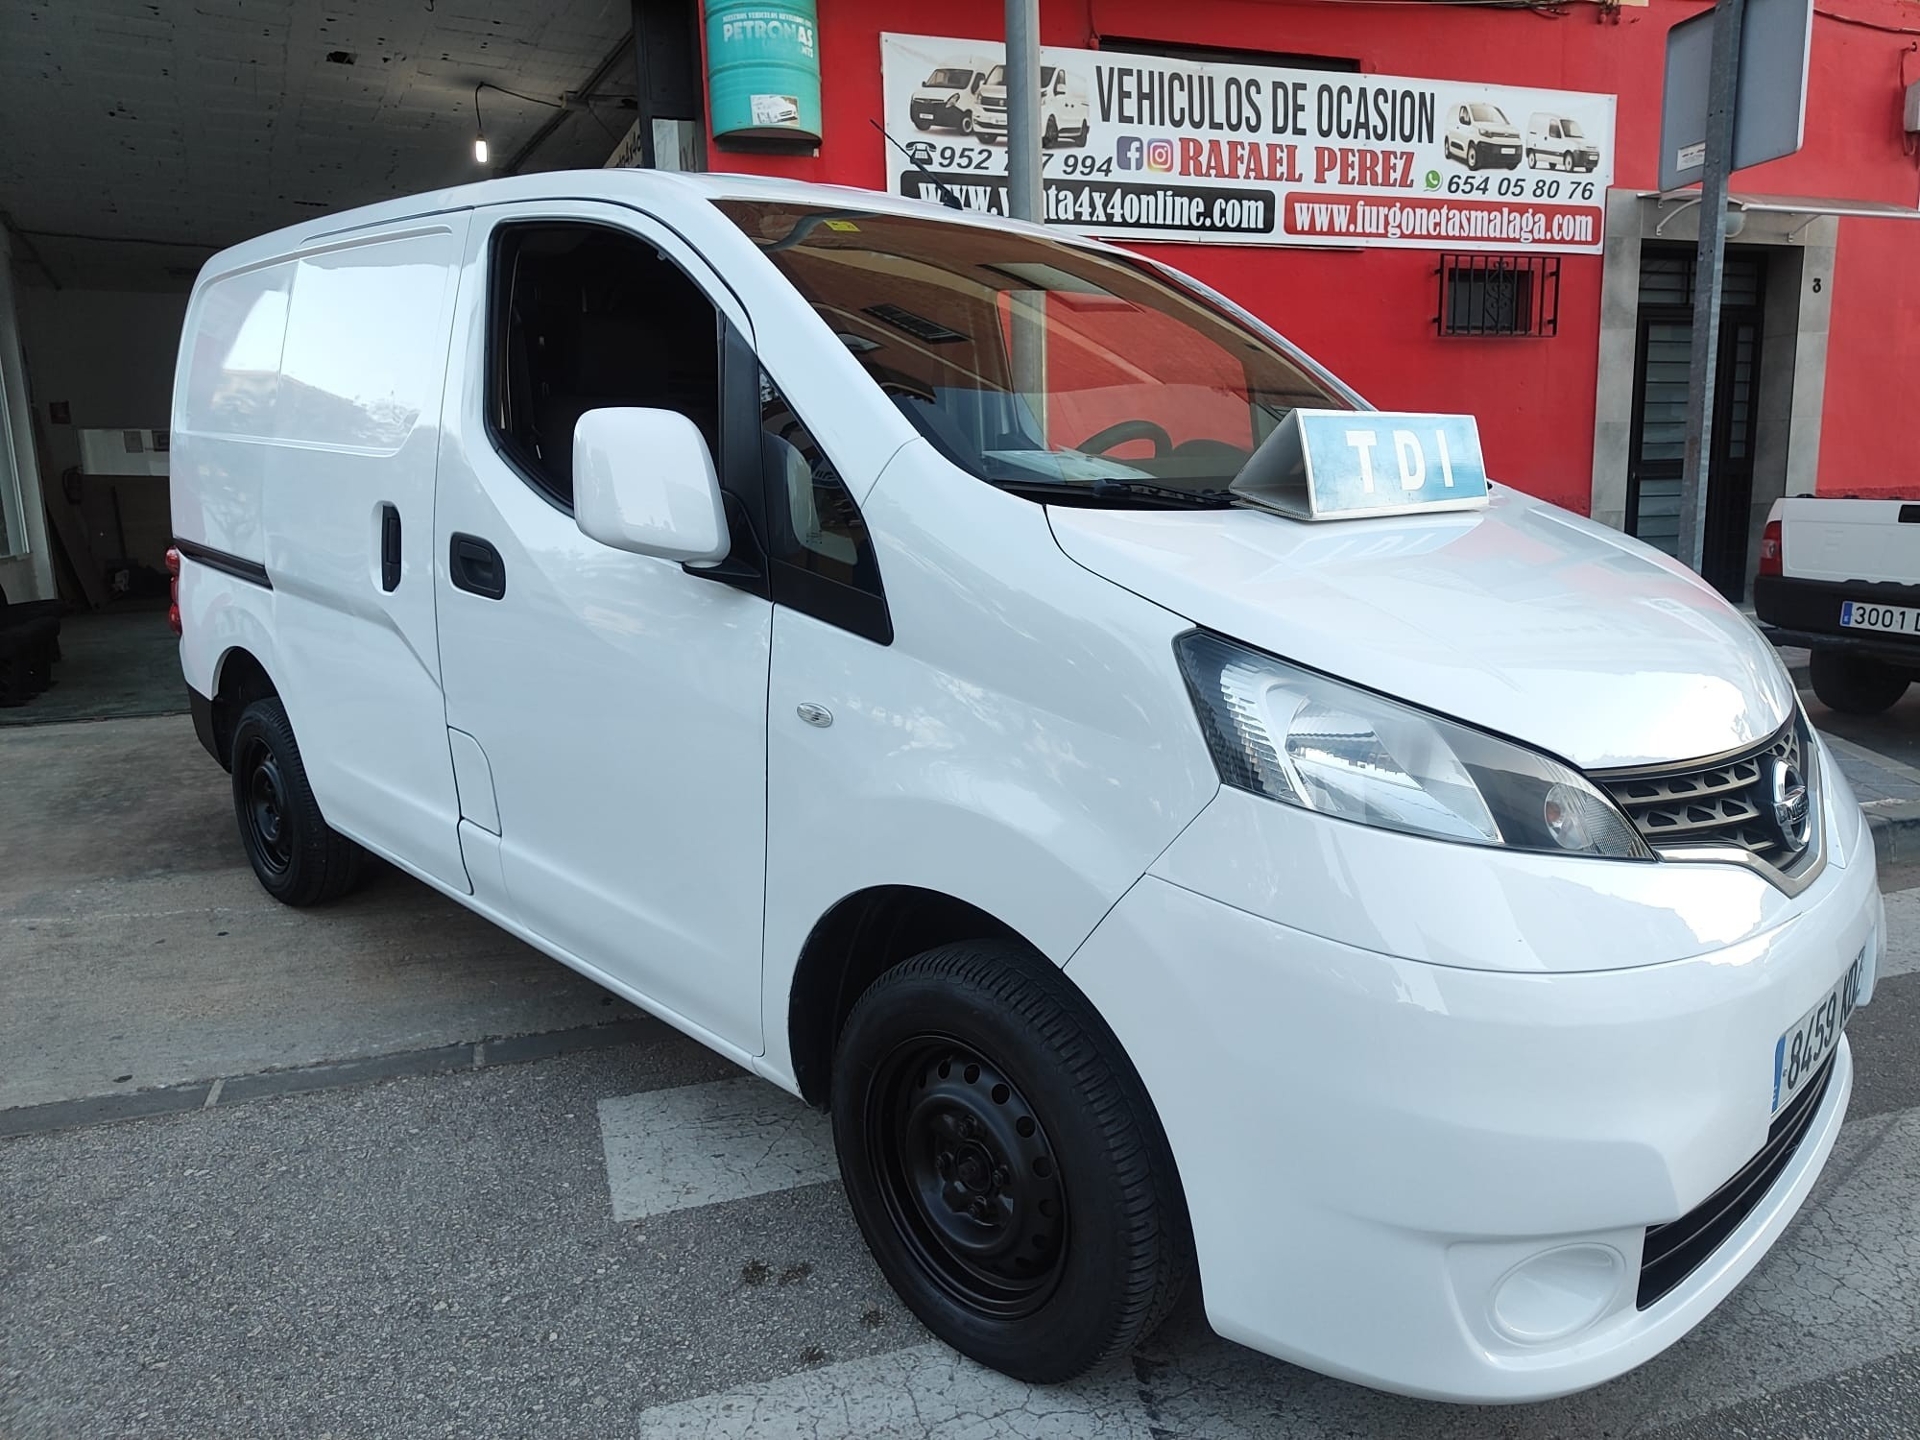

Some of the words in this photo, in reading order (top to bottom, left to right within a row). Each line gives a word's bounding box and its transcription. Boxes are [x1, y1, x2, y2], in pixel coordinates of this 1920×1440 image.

[722, 20, 814, 48] PETRONAS
[1095, 65, 1262, 133] VEHICULOS
[1271, 81, 1307, 136] DE
[1316, 83, 1435, 144] OCASION
[938, 145, 993, 171] 952
[1062, 153, 1113, 177] 994
[1178, 137, 1303, 183] RAFAEL
[1314, 145, 1415, 188] PEREZ
[918, 181, 1265, 230] www.vta4x4online.com
[1447, 174, 1490, 196] 654
[1497, 175, 1526, 198] 05
[1532, 178, 1560, 199] 80
[1569, 181, 1595, 201] 76
[1293, 200, 1593, 244] www.furgonetasmalaga.com
[1812, 278, 1821, 293] 3
[1345, 429, 1455, 493] TDI
[1854, 606, 1907, 631] 3001
[1787, 991, 1838, 1090] 8459
